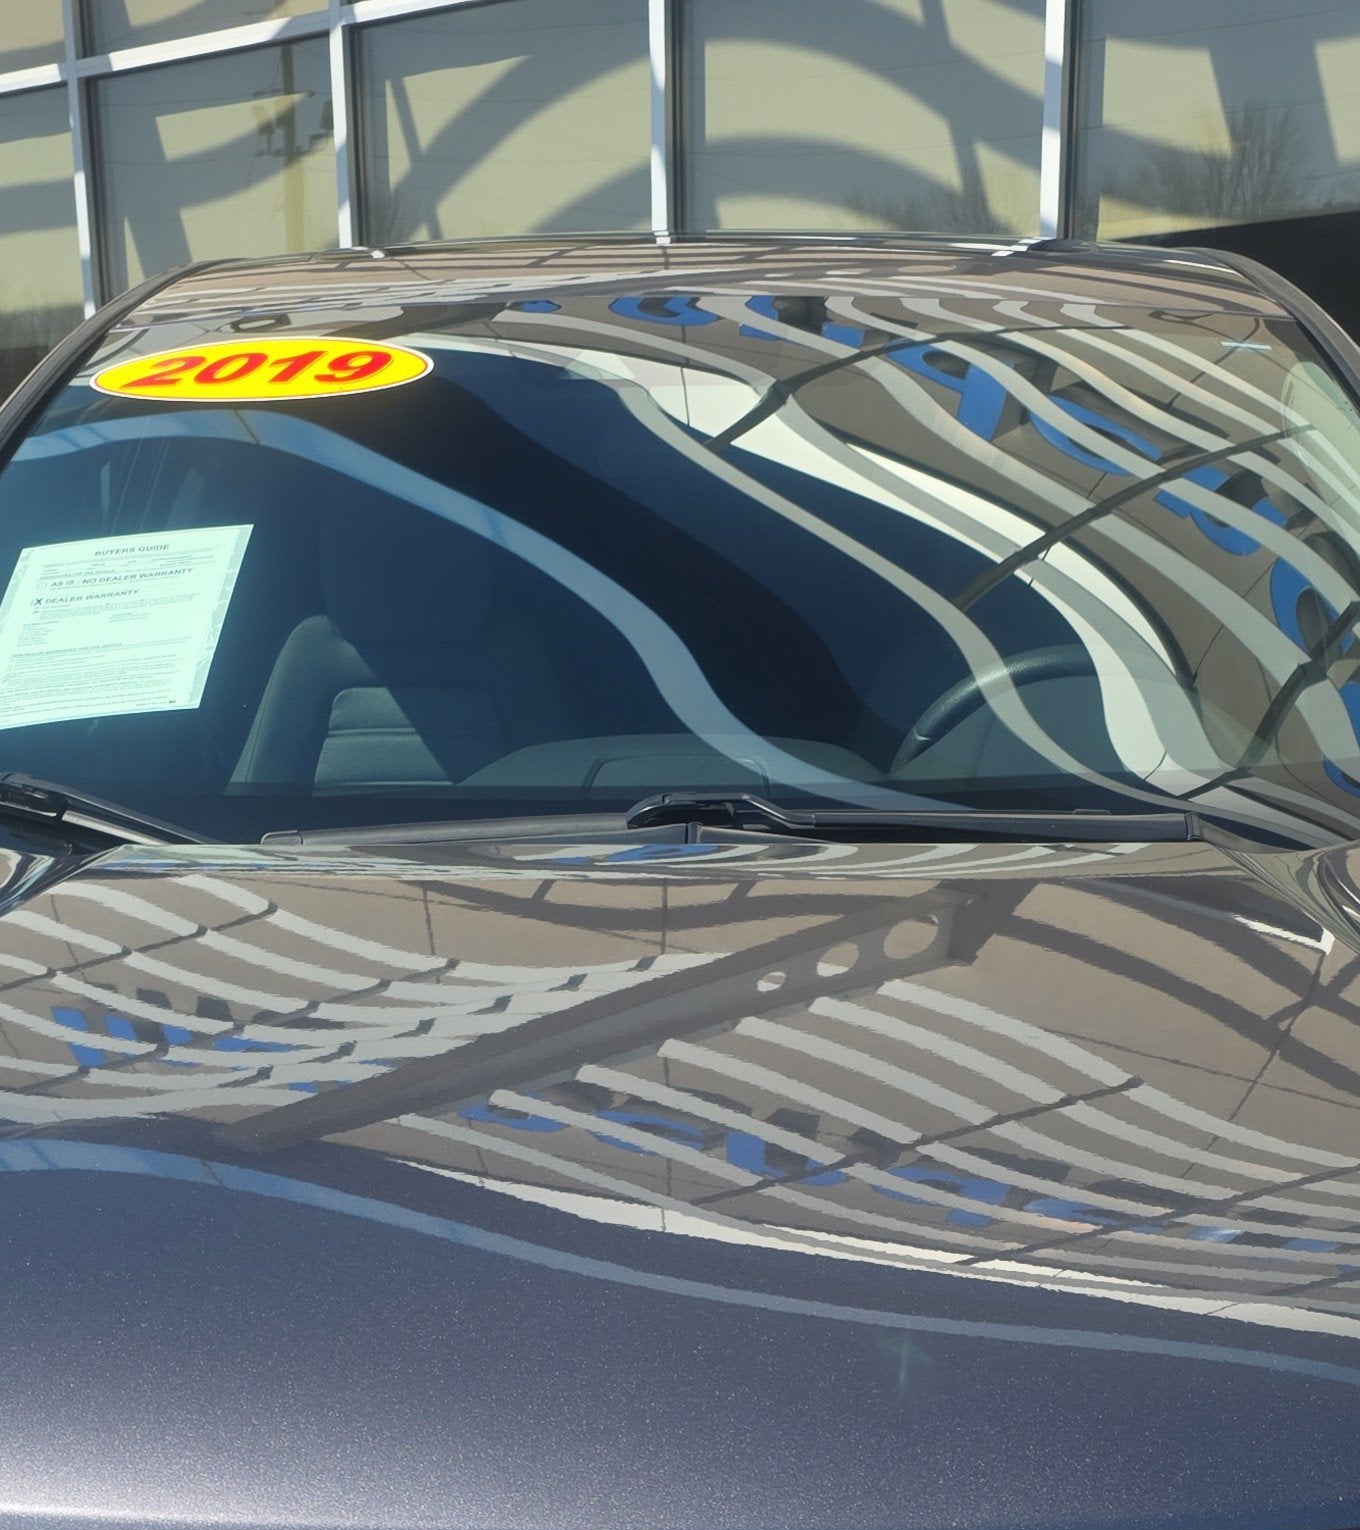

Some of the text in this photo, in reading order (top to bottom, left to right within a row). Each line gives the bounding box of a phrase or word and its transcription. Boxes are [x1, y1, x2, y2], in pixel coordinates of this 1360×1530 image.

[118, 350, 394, 389] 2019
[94, 544, 170, 557] BUYERS GUIDE
[50, 580, 64, 588] AS
[99, 574, 137, 584] DEALER
[139, 567, 194, 579] WARRANTY
[45, 596, 83, 604] DEALER
[85, 589, 140, 600] WARRANTY
